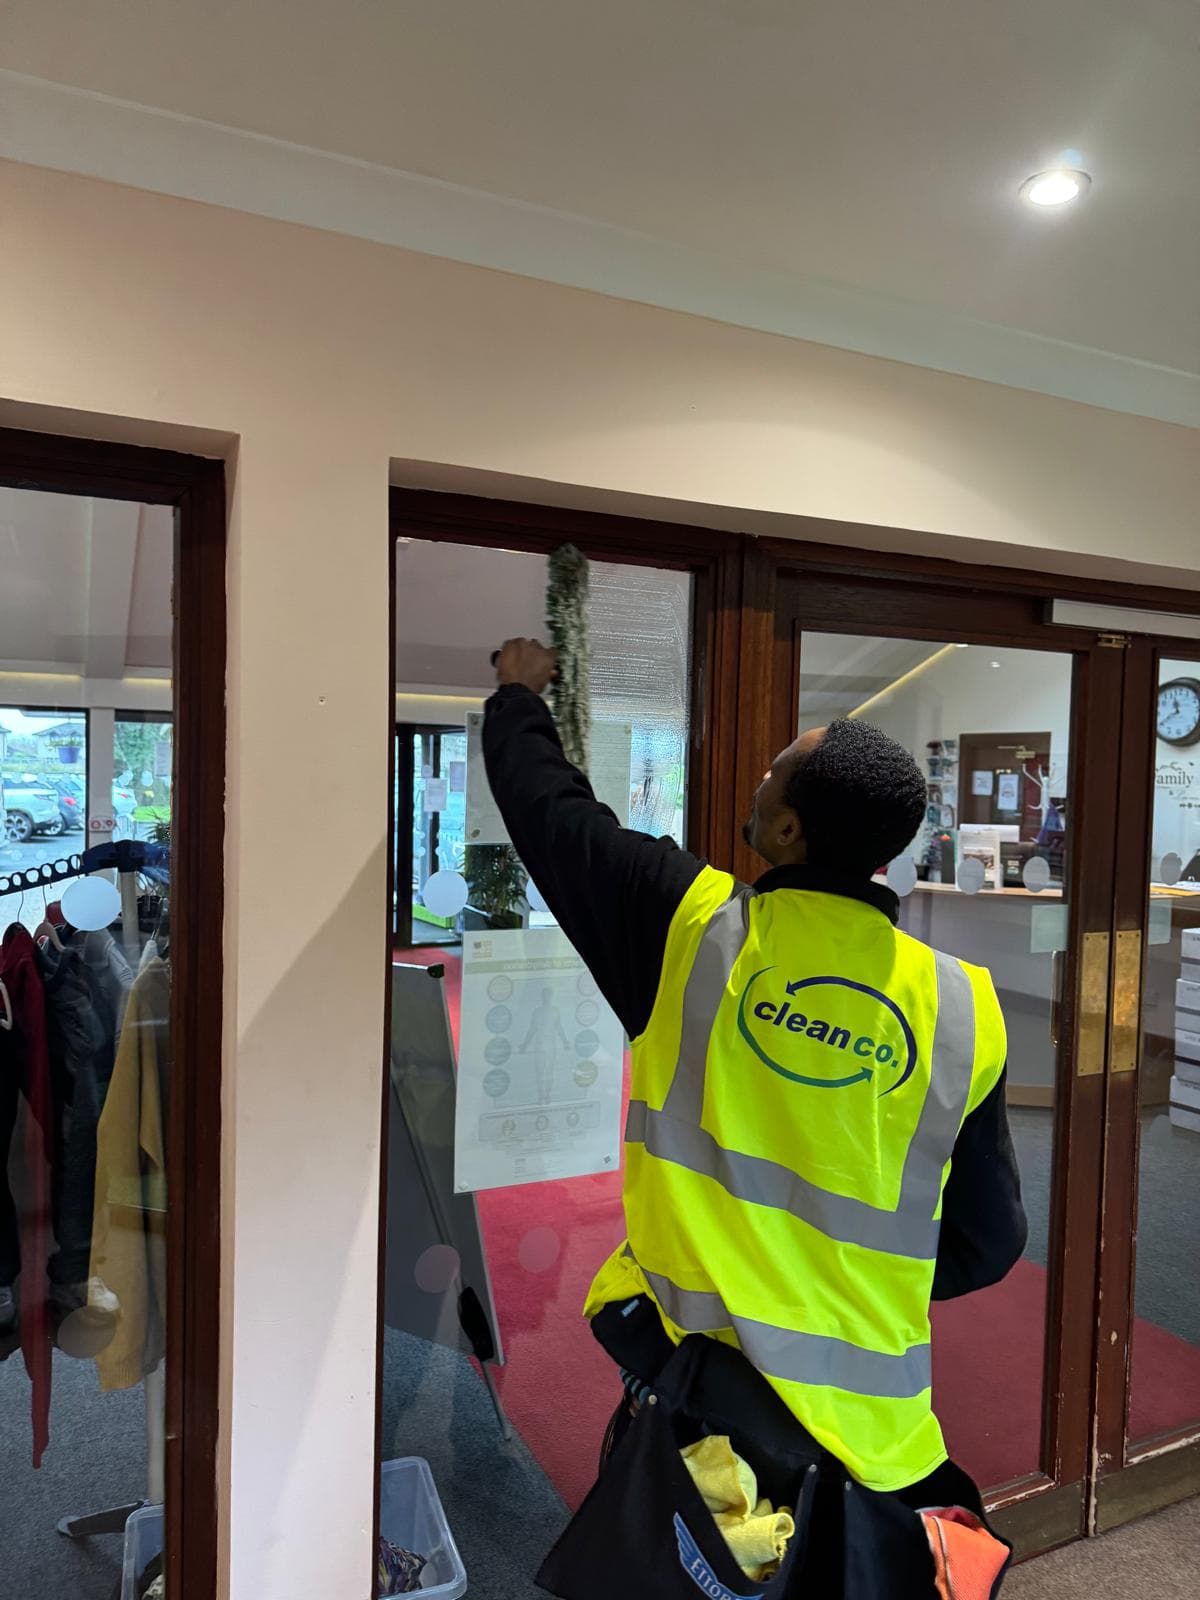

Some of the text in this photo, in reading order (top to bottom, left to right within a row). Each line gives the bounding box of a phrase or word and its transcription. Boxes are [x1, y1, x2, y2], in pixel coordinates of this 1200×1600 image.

[1156, 771, 1194, 789] amily
[754, 1001, 898, 1068] clean co.
